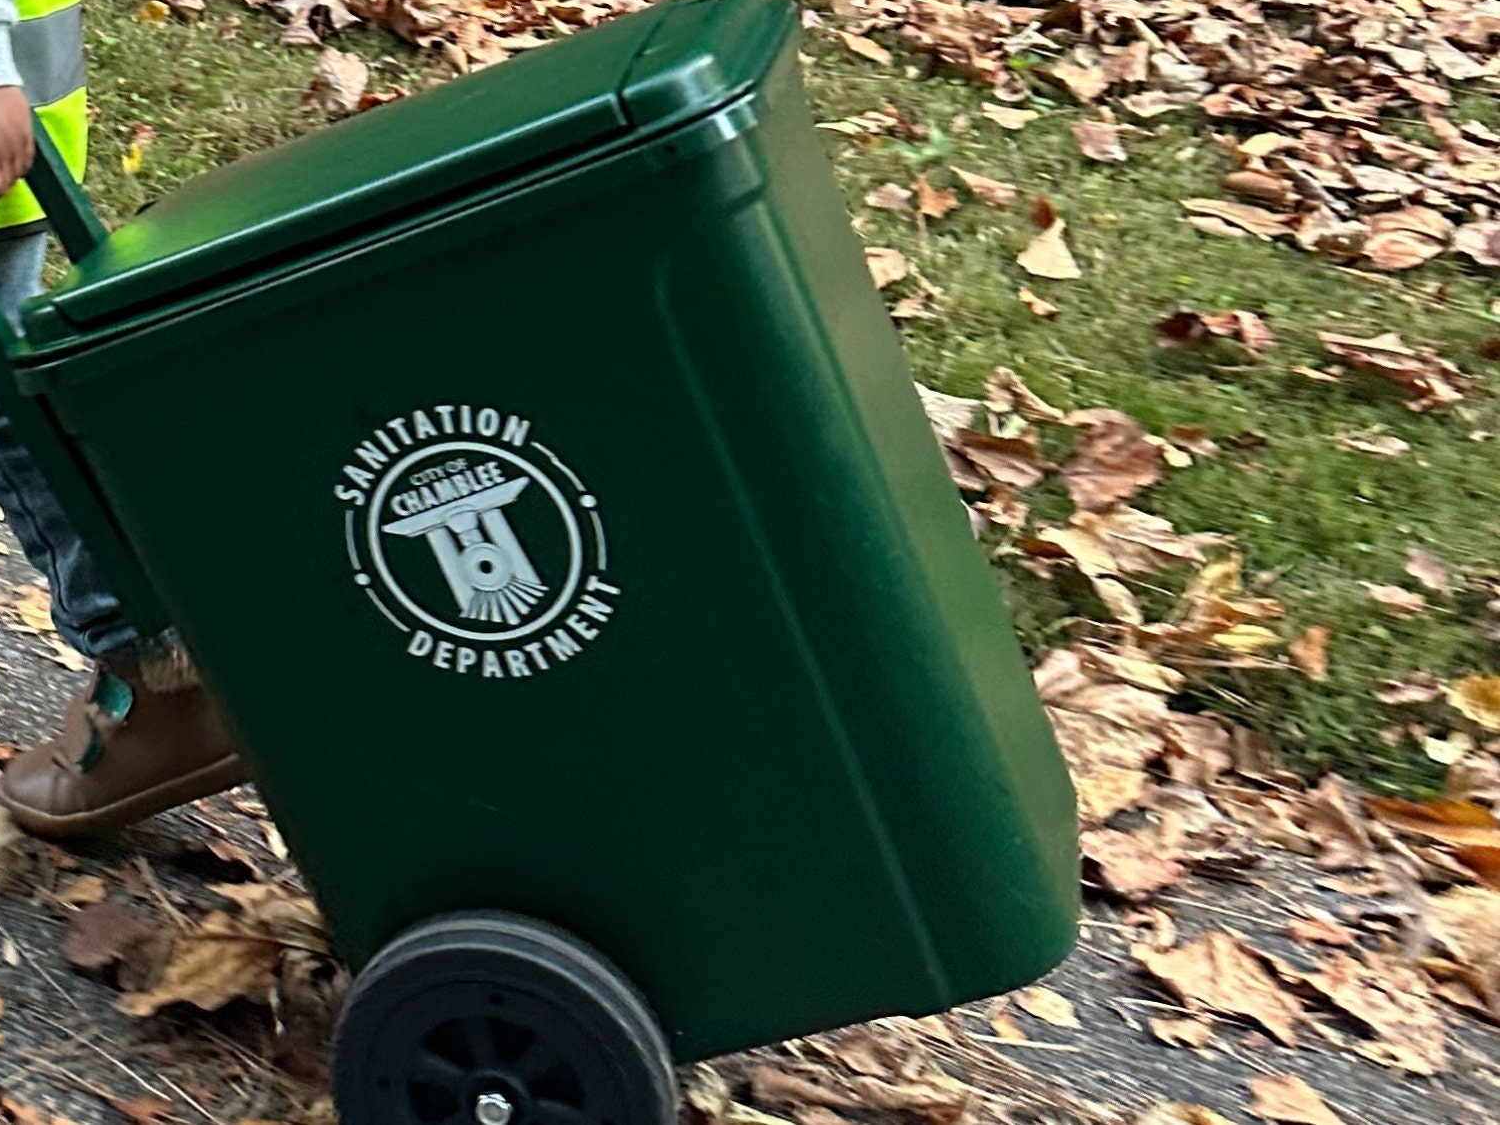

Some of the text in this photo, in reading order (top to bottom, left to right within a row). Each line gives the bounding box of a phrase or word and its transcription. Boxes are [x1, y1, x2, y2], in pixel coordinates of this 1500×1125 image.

[334, 405, 530, 506] SANITATION
[390, 461, 506, 516] CHAMBLEE
[409, 458, 468, 486] CITY OF
[407, 576, 621, 678] DEPARTMENT
